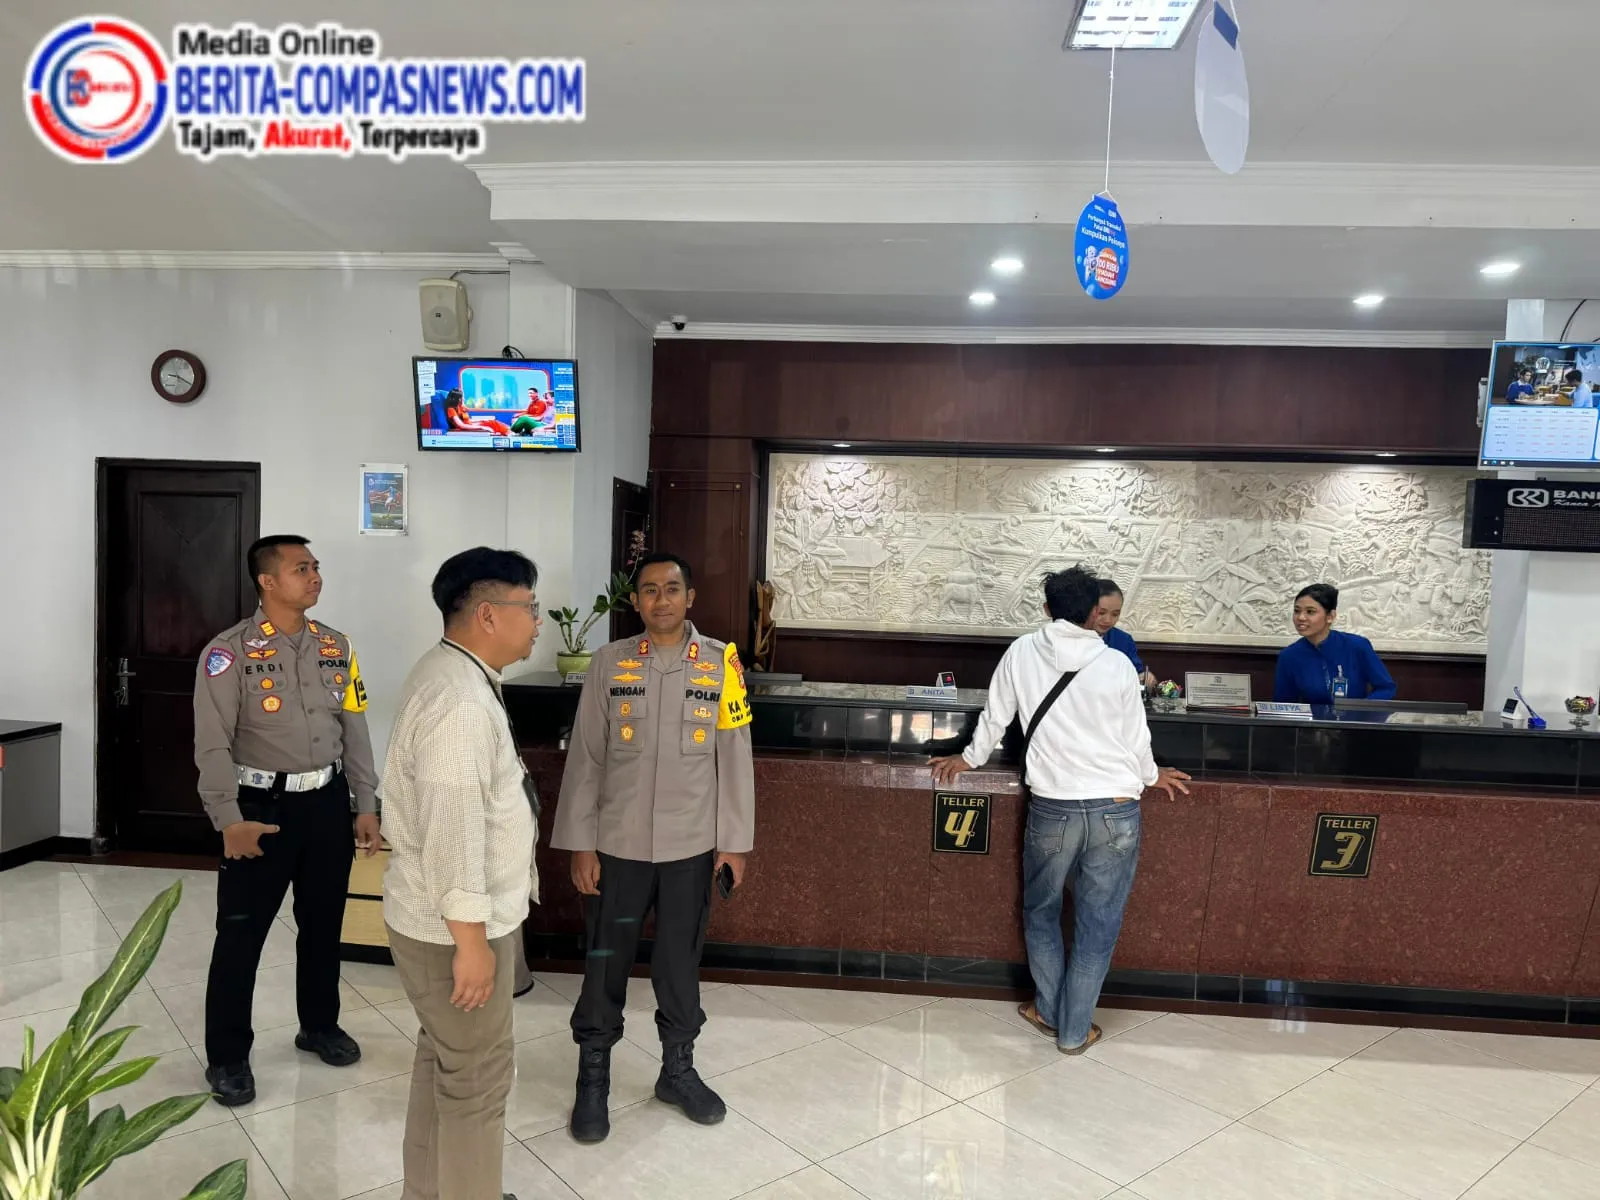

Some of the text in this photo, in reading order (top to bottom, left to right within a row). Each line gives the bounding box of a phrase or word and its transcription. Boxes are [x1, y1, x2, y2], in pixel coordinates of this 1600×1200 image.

[318, 659, 348, 669] POLRI
[610, 686, 646, 697] NENGAH
[685, 689, 721, 702] POLRI
[1270, 704, 1302, 712] LISTYA
[941, 796, 985, 807] TELLER
[944, 810, 979, 847] 4
[1324, 819, 1371, 829] TELLER
[1320, 832, 1366, 870] 3
